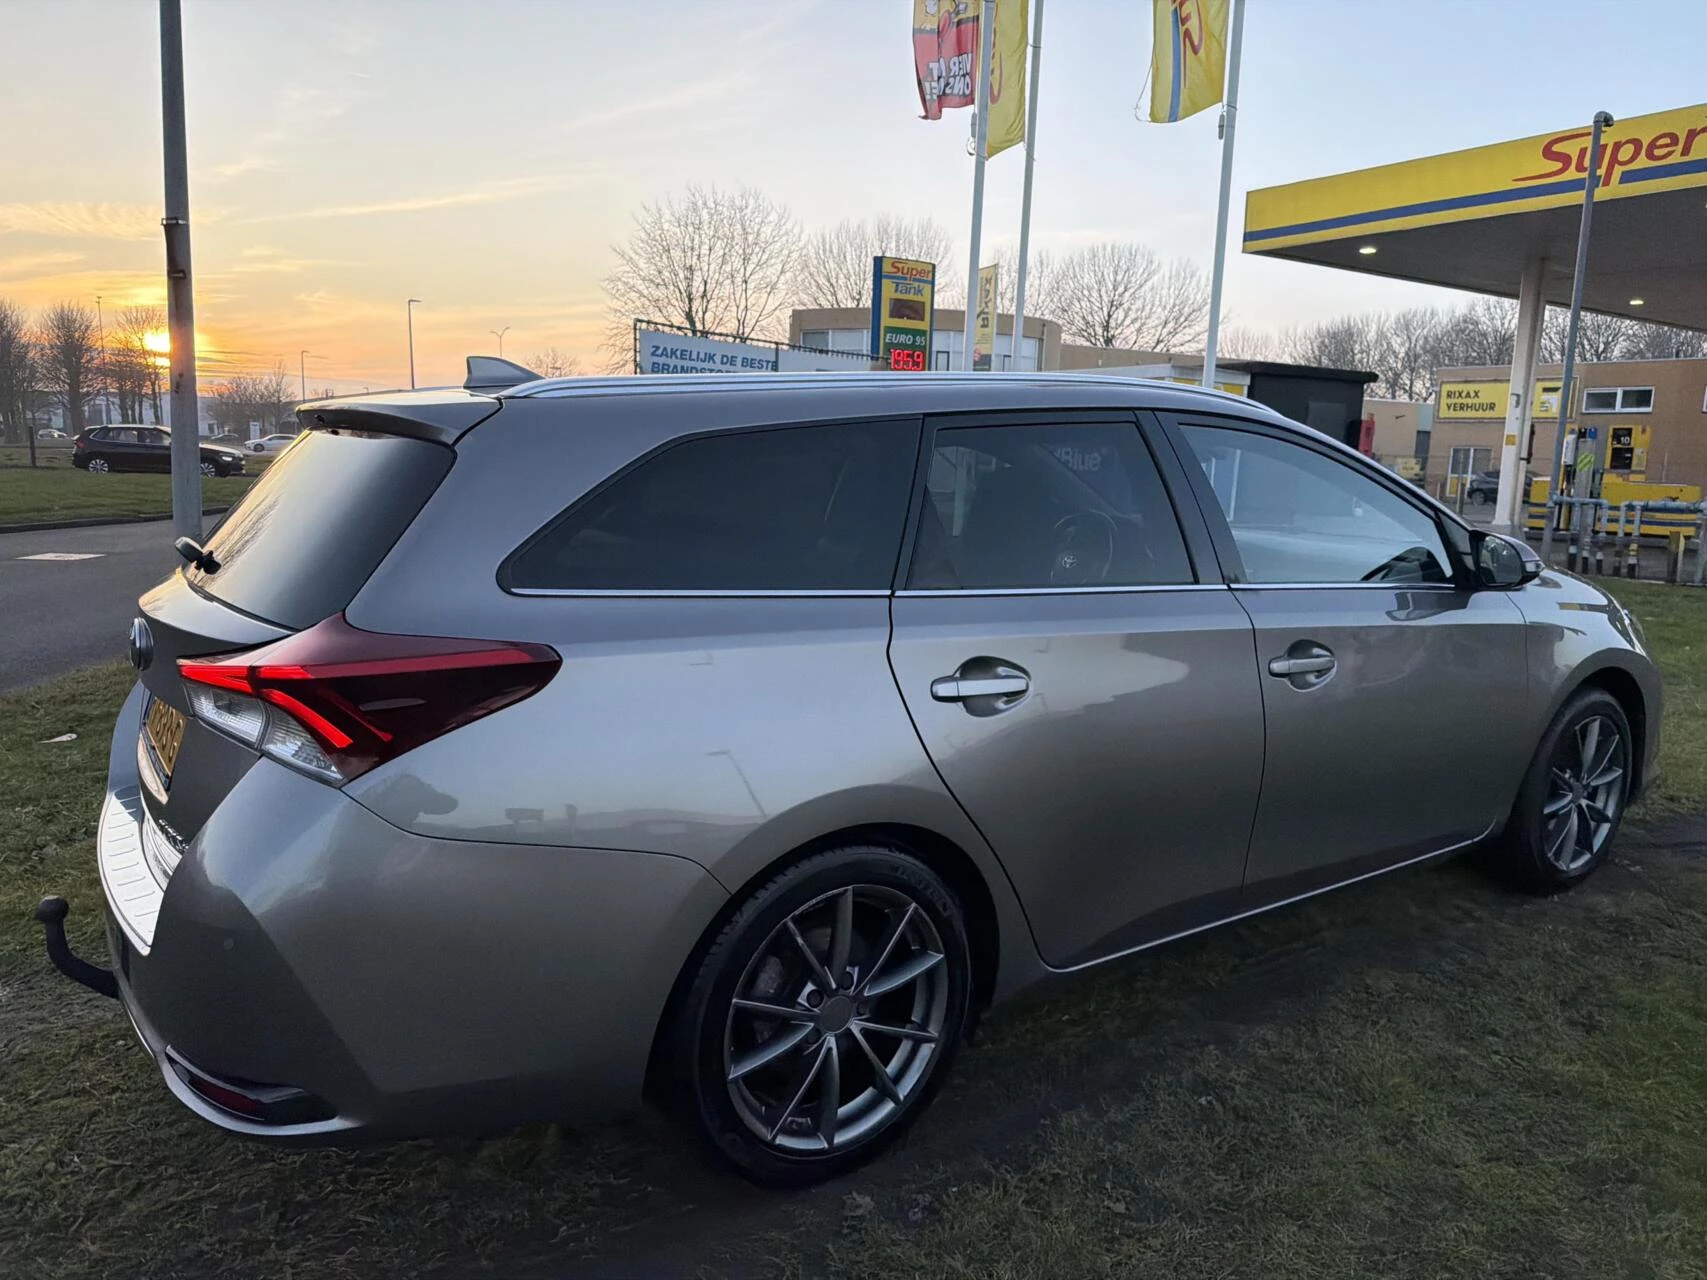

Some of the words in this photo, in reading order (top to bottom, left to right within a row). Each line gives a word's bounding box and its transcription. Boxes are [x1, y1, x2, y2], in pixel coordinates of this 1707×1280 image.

[1512, 126, 1707, 187] Super
[882, 260, 931, 282] Super
[892, 280, 925, 297] Tank
[885, 333, 914, 345] EURO
[915, 335, 925, 346] 95
[651, 345, 717, 365] ZAKELIJK
[720, 354, 738, 367] DE
[741, 357, 777, 372] BESTE
[1446, 389, 1480, 400] RIXAX
[1446, 401, 1497, 413] VERHUUR
[1620, 436, 1630, 445] 10
